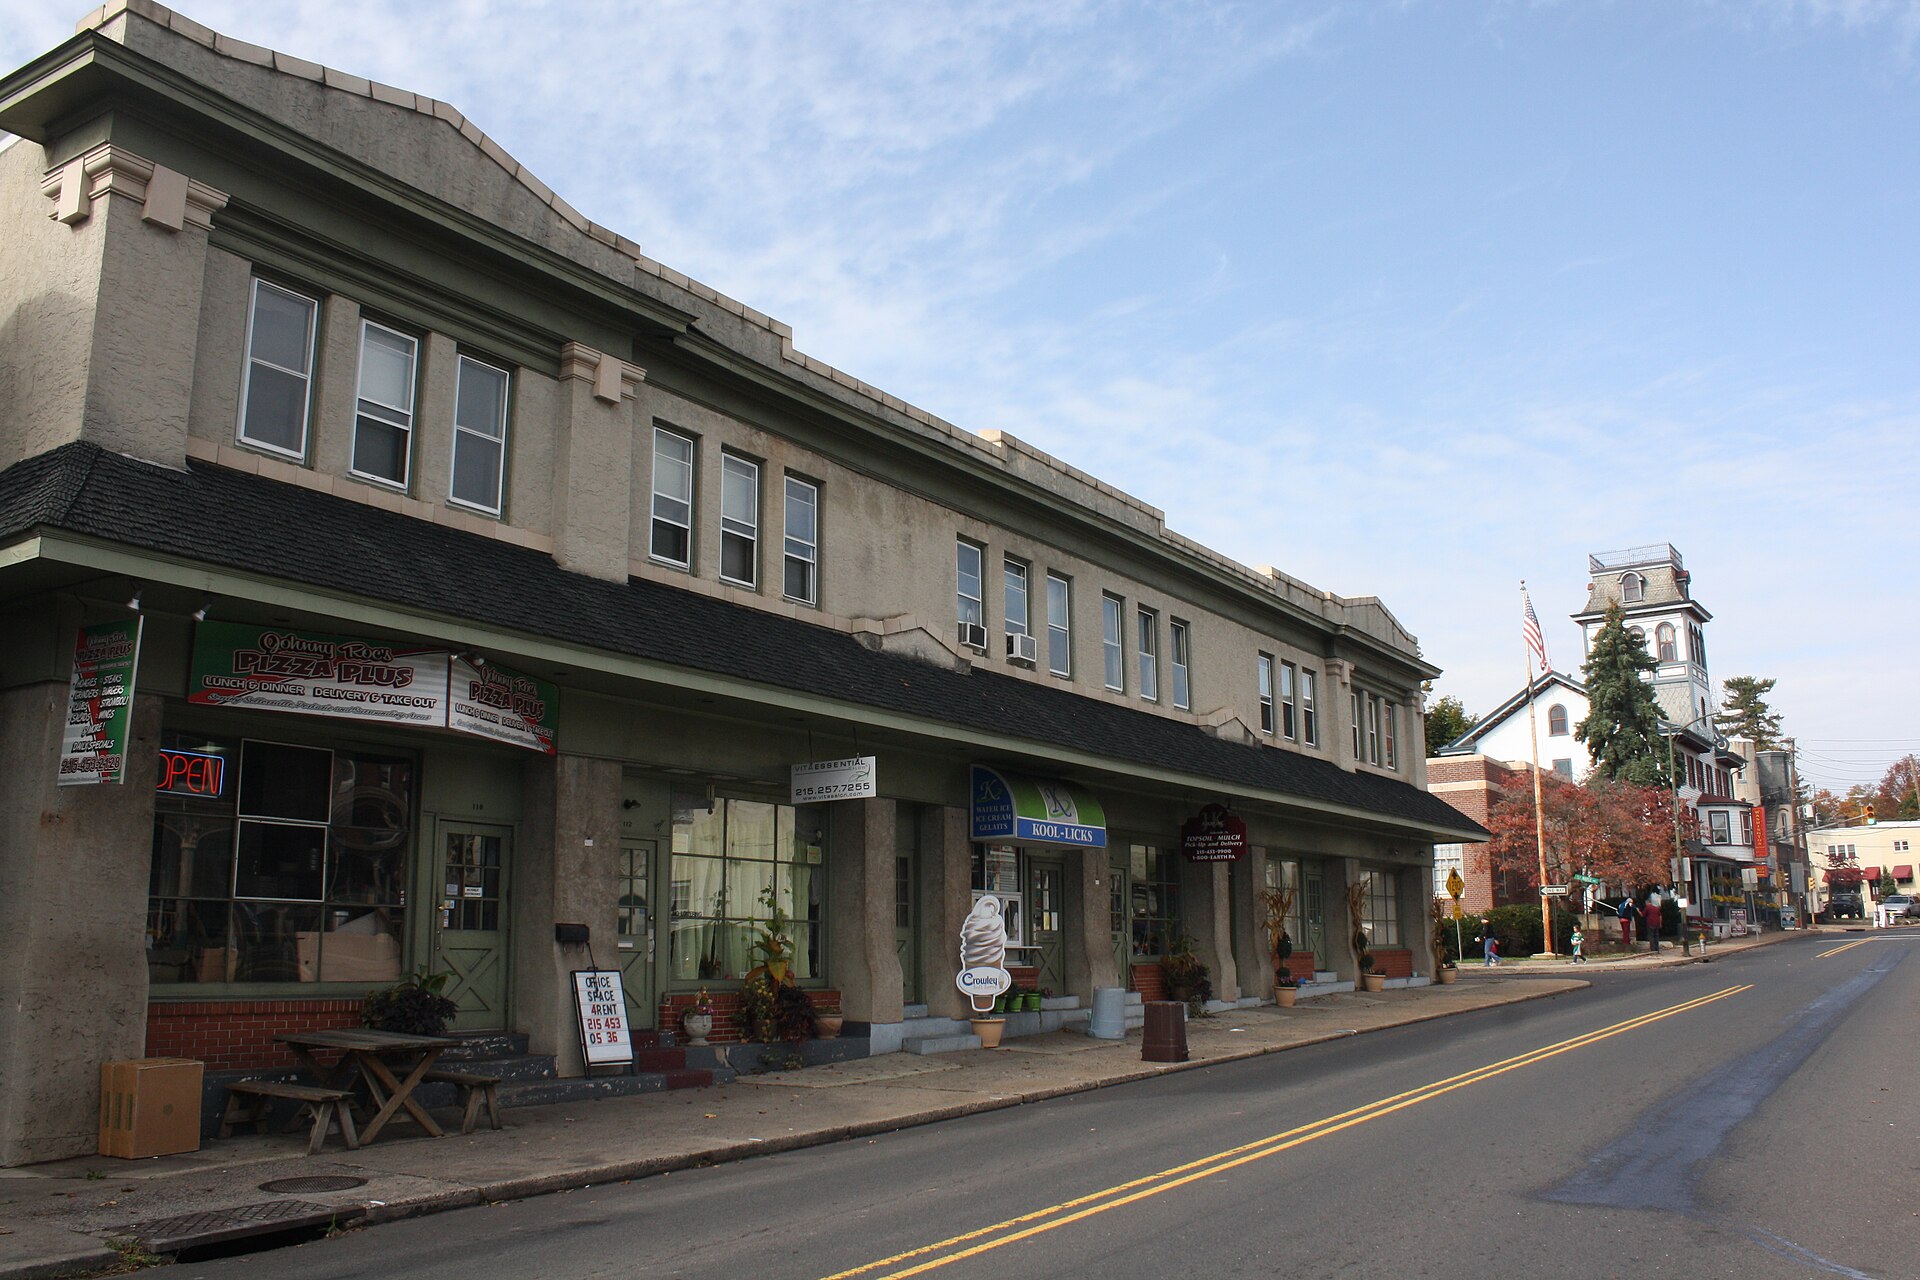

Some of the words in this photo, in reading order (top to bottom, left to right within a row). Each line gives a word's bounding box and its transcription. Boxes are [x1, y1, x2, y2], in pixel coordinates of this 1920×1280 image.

[109, 640, 134, 658] PLUS
[259, 631, 336, 660] Johnny
[338, 641, 394, 662] Roc's
[233, 649, 335, 679] PIZZA
[337, 662, 415, 688] PLUS
[102, 674, 123, 686] STEAKS
[101, 685, 125, 697] BURGERS
[203, 675, 246, 689] LUNCH
[247, 680, 260, 690] &
[260, 682, 305, 696] DINNER
[313, 687, 369, 702] DELIVERY
[370, 692, 380, 703] &
[381, 693, 412, 706] TAKE
[413, 697, 438, 709] OUT
[100, 696, 130, 708] STROMBOLI
[470, 680, 512, 710] PIZZA
[513, 695, 545, 721] PLUS
[60, 755, 122, 774] 215-453-2128
[795, 782, 870, 796] 215.257.7255
[976, 804, 1000, 813] WATER
[1000, 803, 1011, 812] ICE
[988, 813, 1011, 822] CREAM
[1032, 823, 1093, 842] KOOL-LICKS
[962, 972, 998, 986] Crowley
[588, 990, 615, 1002] SPACE
[587, 1018, 602, 1030] 215
[605, 1018, 621, 1029] 453
[590, 1033, 602, 1044] 05
[607, 1032, 618, 1043] 36
